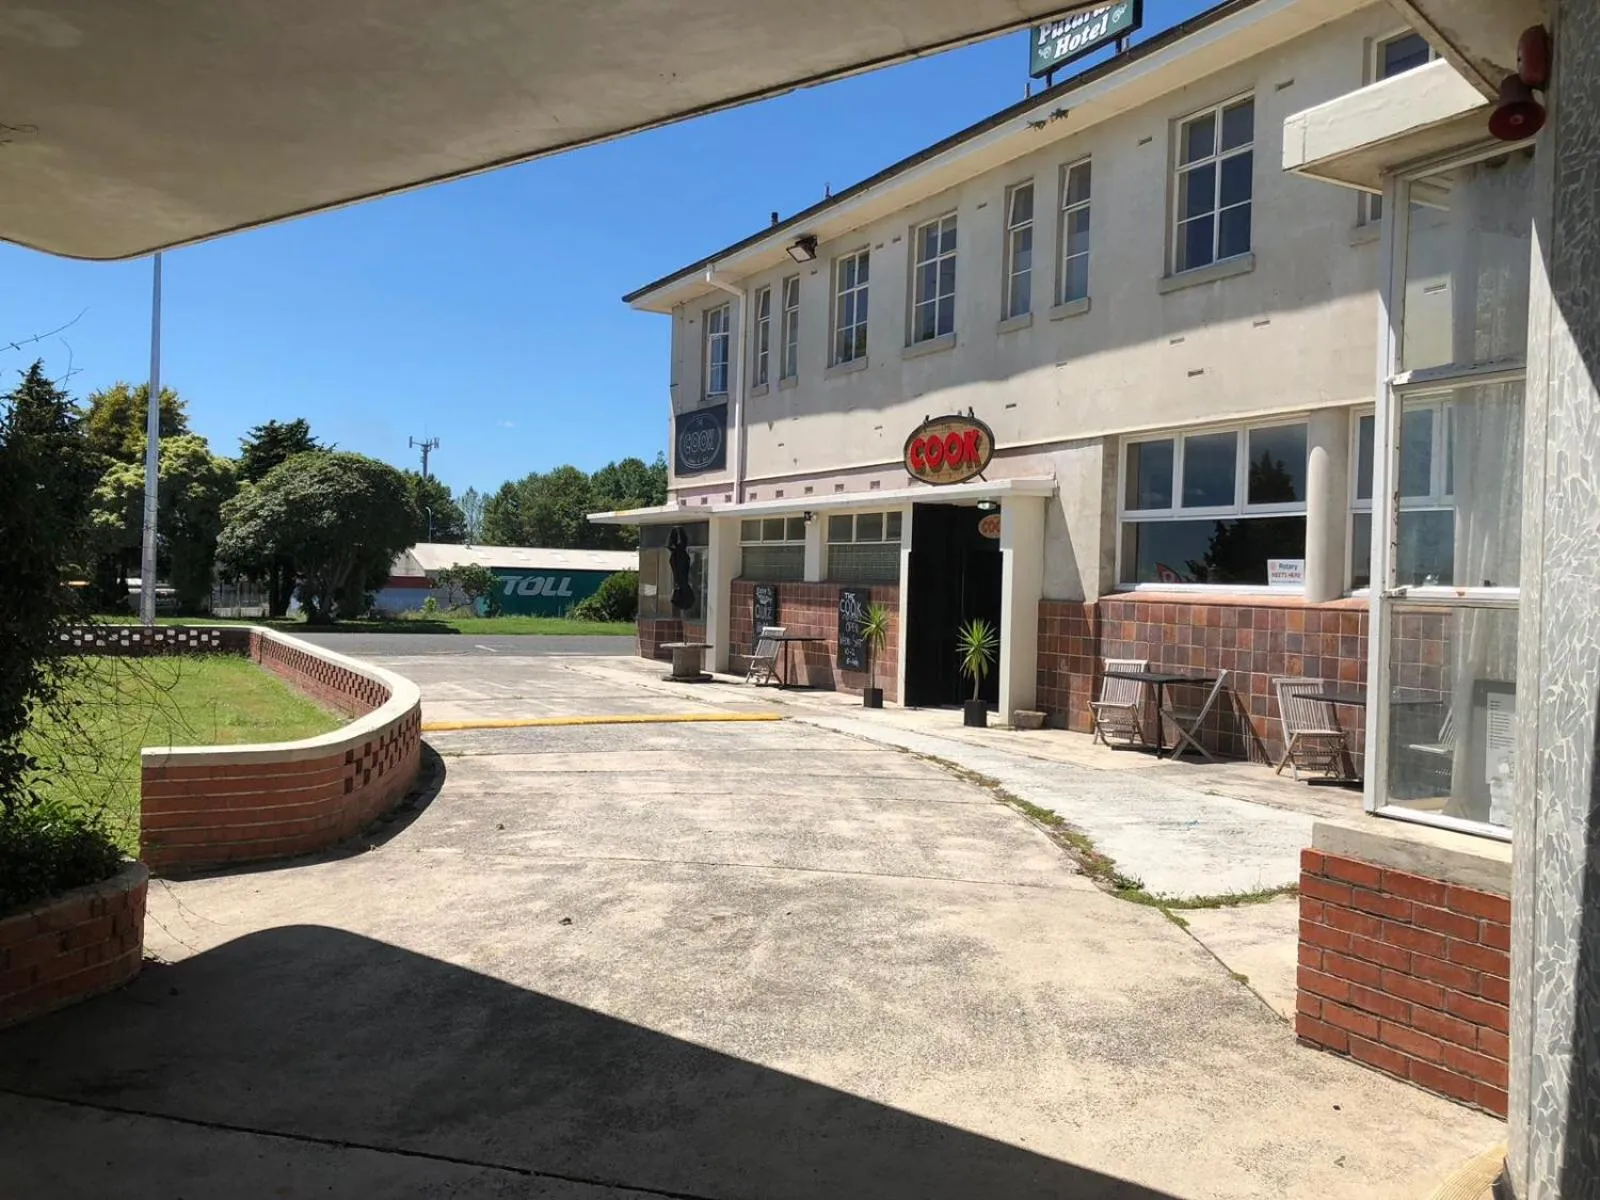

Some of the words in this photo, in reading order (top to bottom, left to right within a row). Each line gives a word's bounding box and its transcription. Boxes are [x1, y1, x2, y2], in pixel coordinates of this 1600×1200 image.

[1053, 13, 1109, 58] Hotel
[909, 430, 981, 472] COOK
[1279, 563, 1298, 571] Rotary
[499, 576, 573, 597] TOLL
[840, 599, 863, 617] COOK
